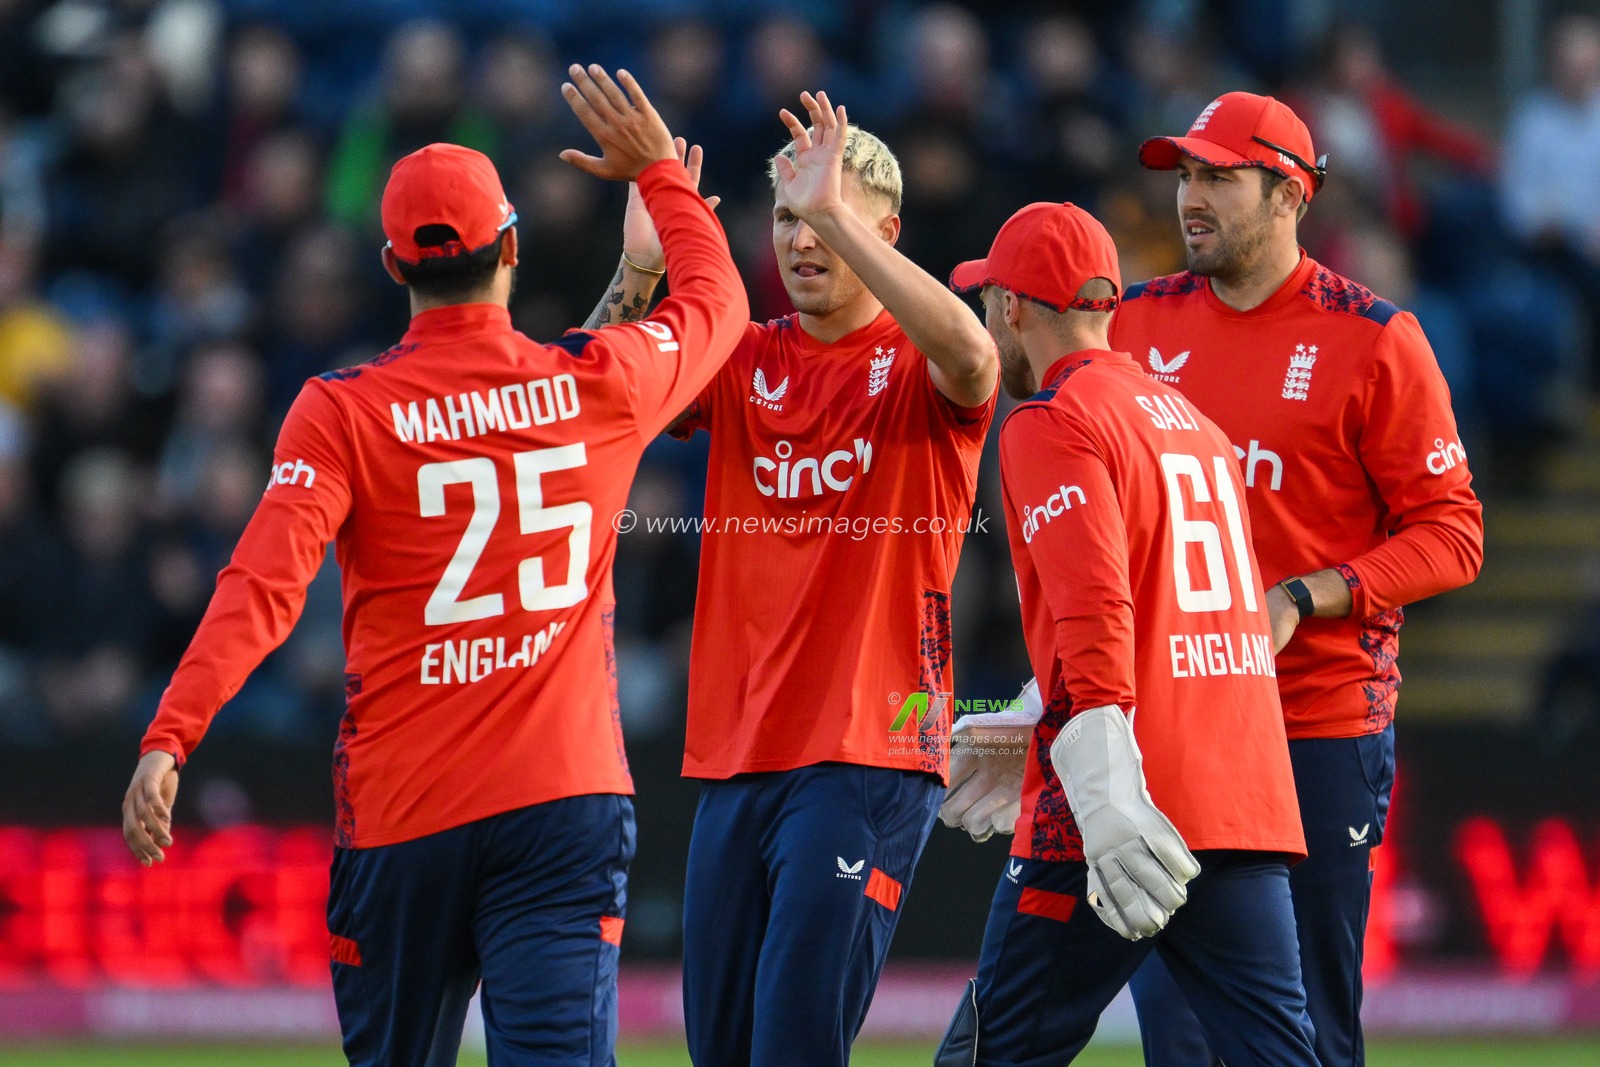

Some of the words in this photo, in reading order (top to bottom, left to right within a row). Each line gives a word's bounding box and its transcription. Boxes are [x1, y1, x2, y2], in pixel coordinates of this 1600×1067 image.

[391, 374, 580, 443] MAHMOOD
[1134, 394, 1200, 431] SALT
[266, 459, 316, 490] nch
[417, 442, 592, 626] 25
[1022, 485, 1087, 544] cinch
[1160, 453, 1258, 612] 61
